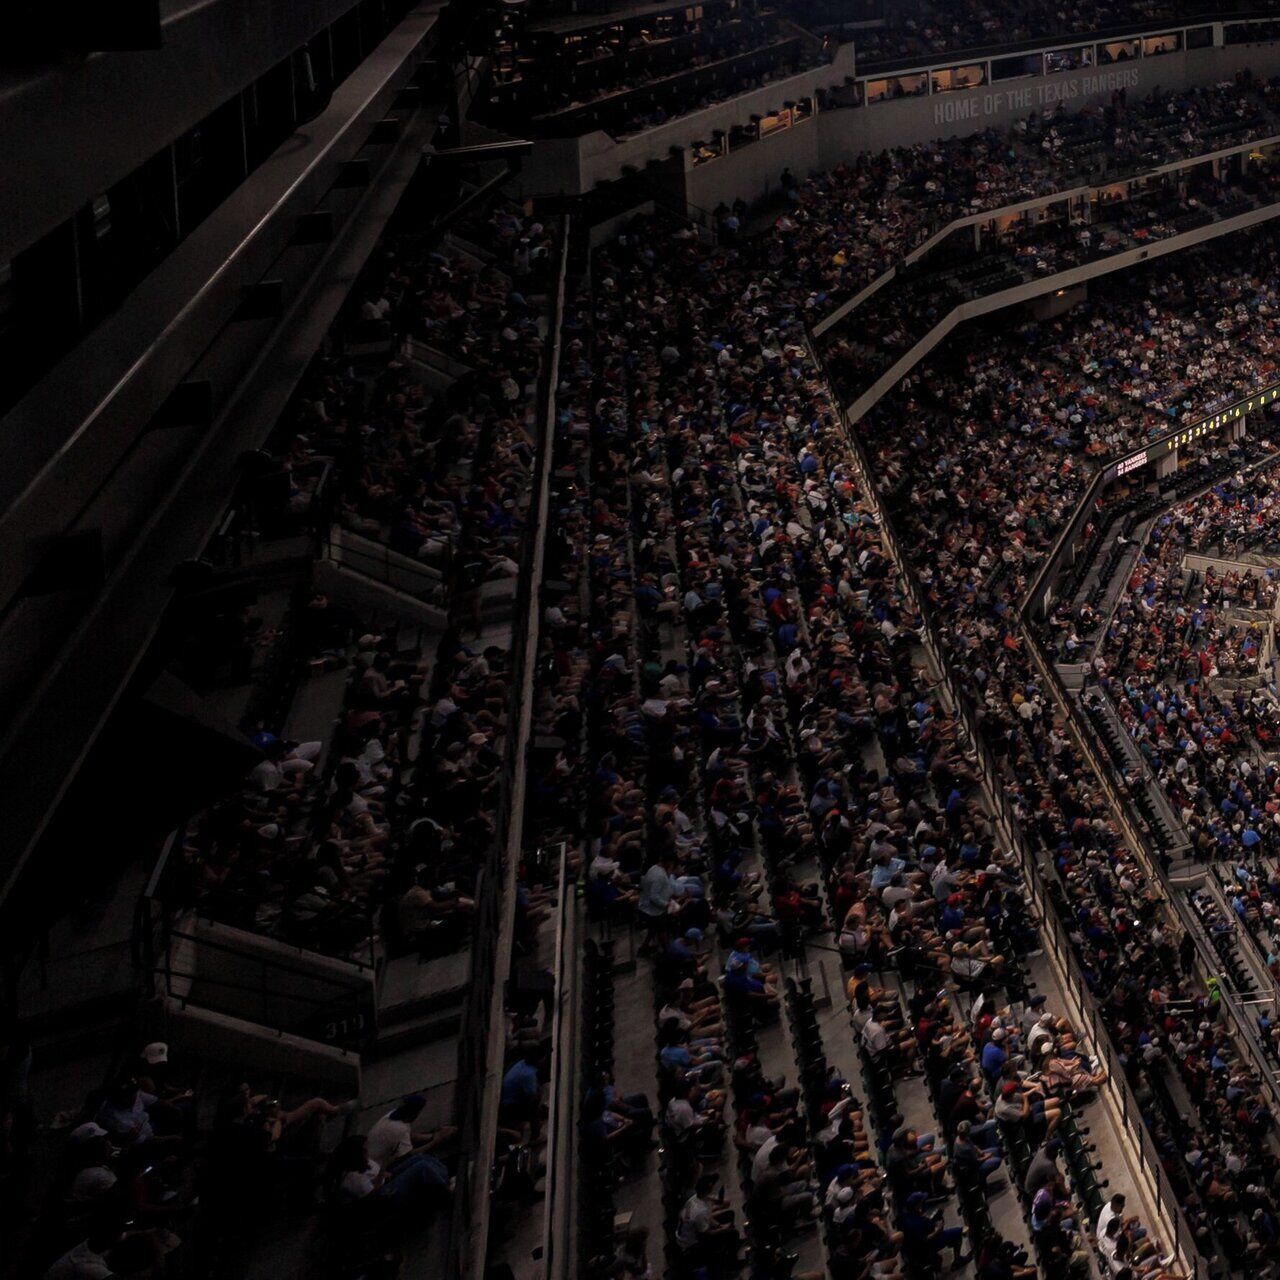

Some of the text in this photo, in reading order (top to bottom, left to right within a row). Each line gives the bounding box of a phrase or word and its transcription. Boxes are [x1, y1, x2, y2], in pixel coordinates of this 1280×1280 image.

[934, 69, 1138, 124] HOME OF THE TEXAS RANGERS
